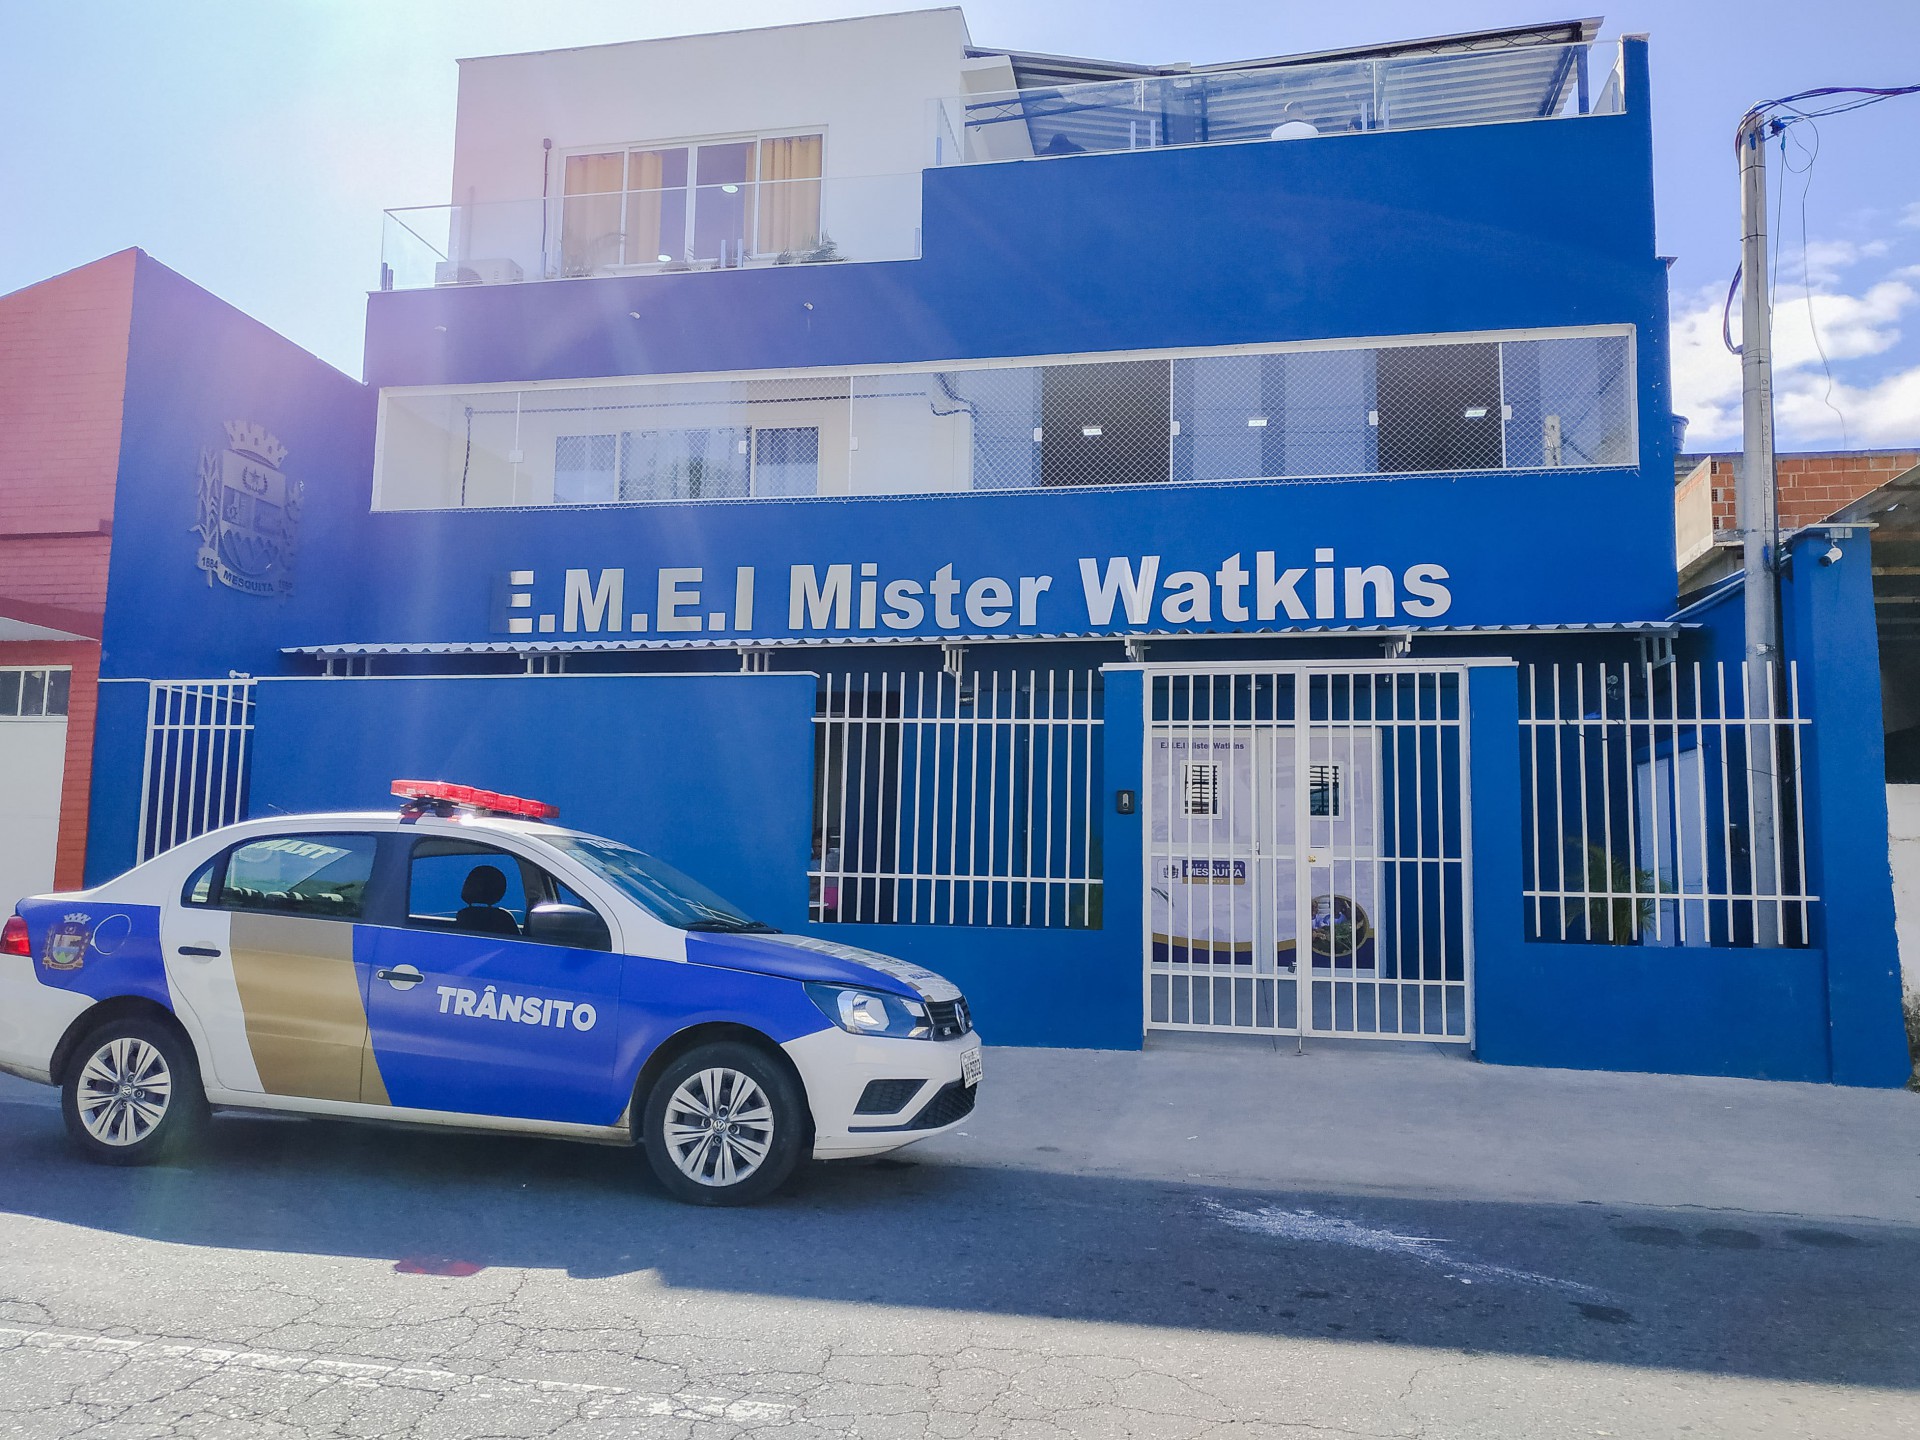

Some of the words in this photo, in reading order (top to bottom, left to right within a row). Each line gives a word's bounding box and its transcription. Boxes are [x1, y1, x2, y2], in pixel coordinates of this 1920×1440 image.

[223, 569, 274, 592] MESQUITA
[788, 562, 1053, 631] Mister
[1078, 547, 1452, 626] Watkins
[436, 985, 597, 1032] TRÂNSITO
